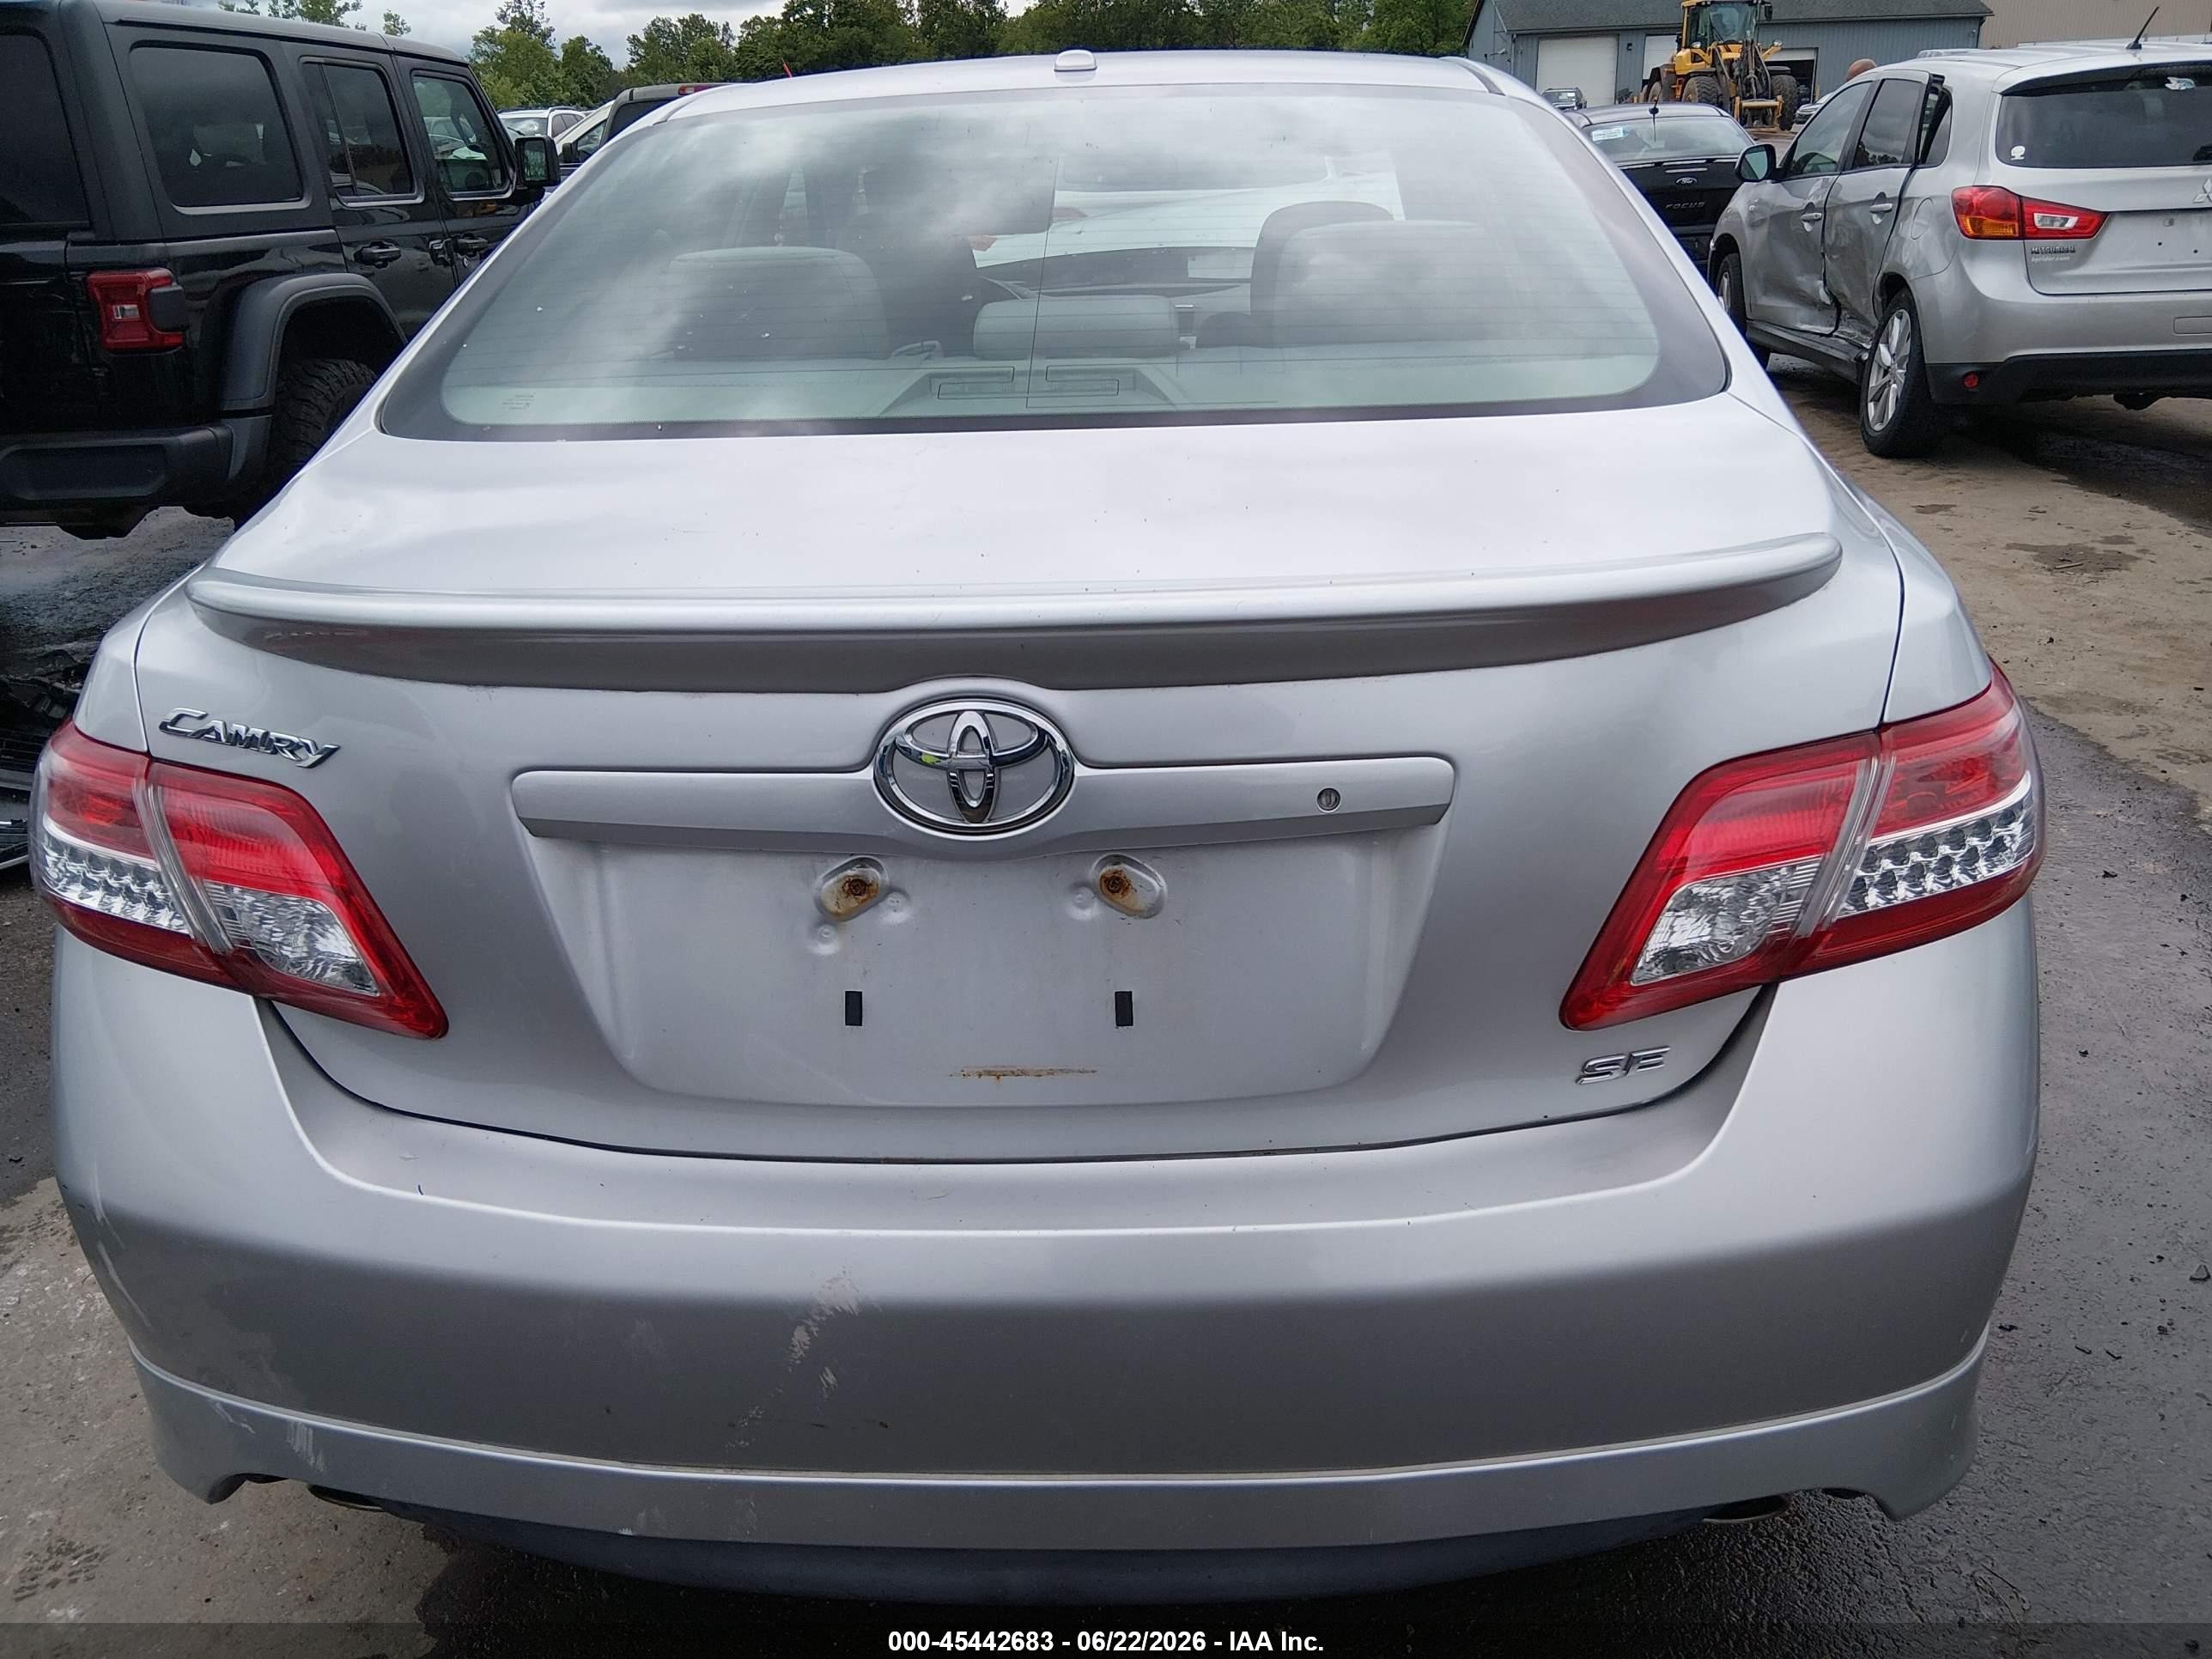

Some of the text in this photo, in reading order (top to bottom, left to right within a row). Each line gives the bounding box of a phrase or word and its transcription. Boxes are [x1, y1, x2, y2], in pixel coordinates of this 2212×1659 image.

[1665, 201, 1706, 210] FOCUS
[158, 707, 341, 769] CAMRY
[1574, 1045, 1670, 1085] SE
